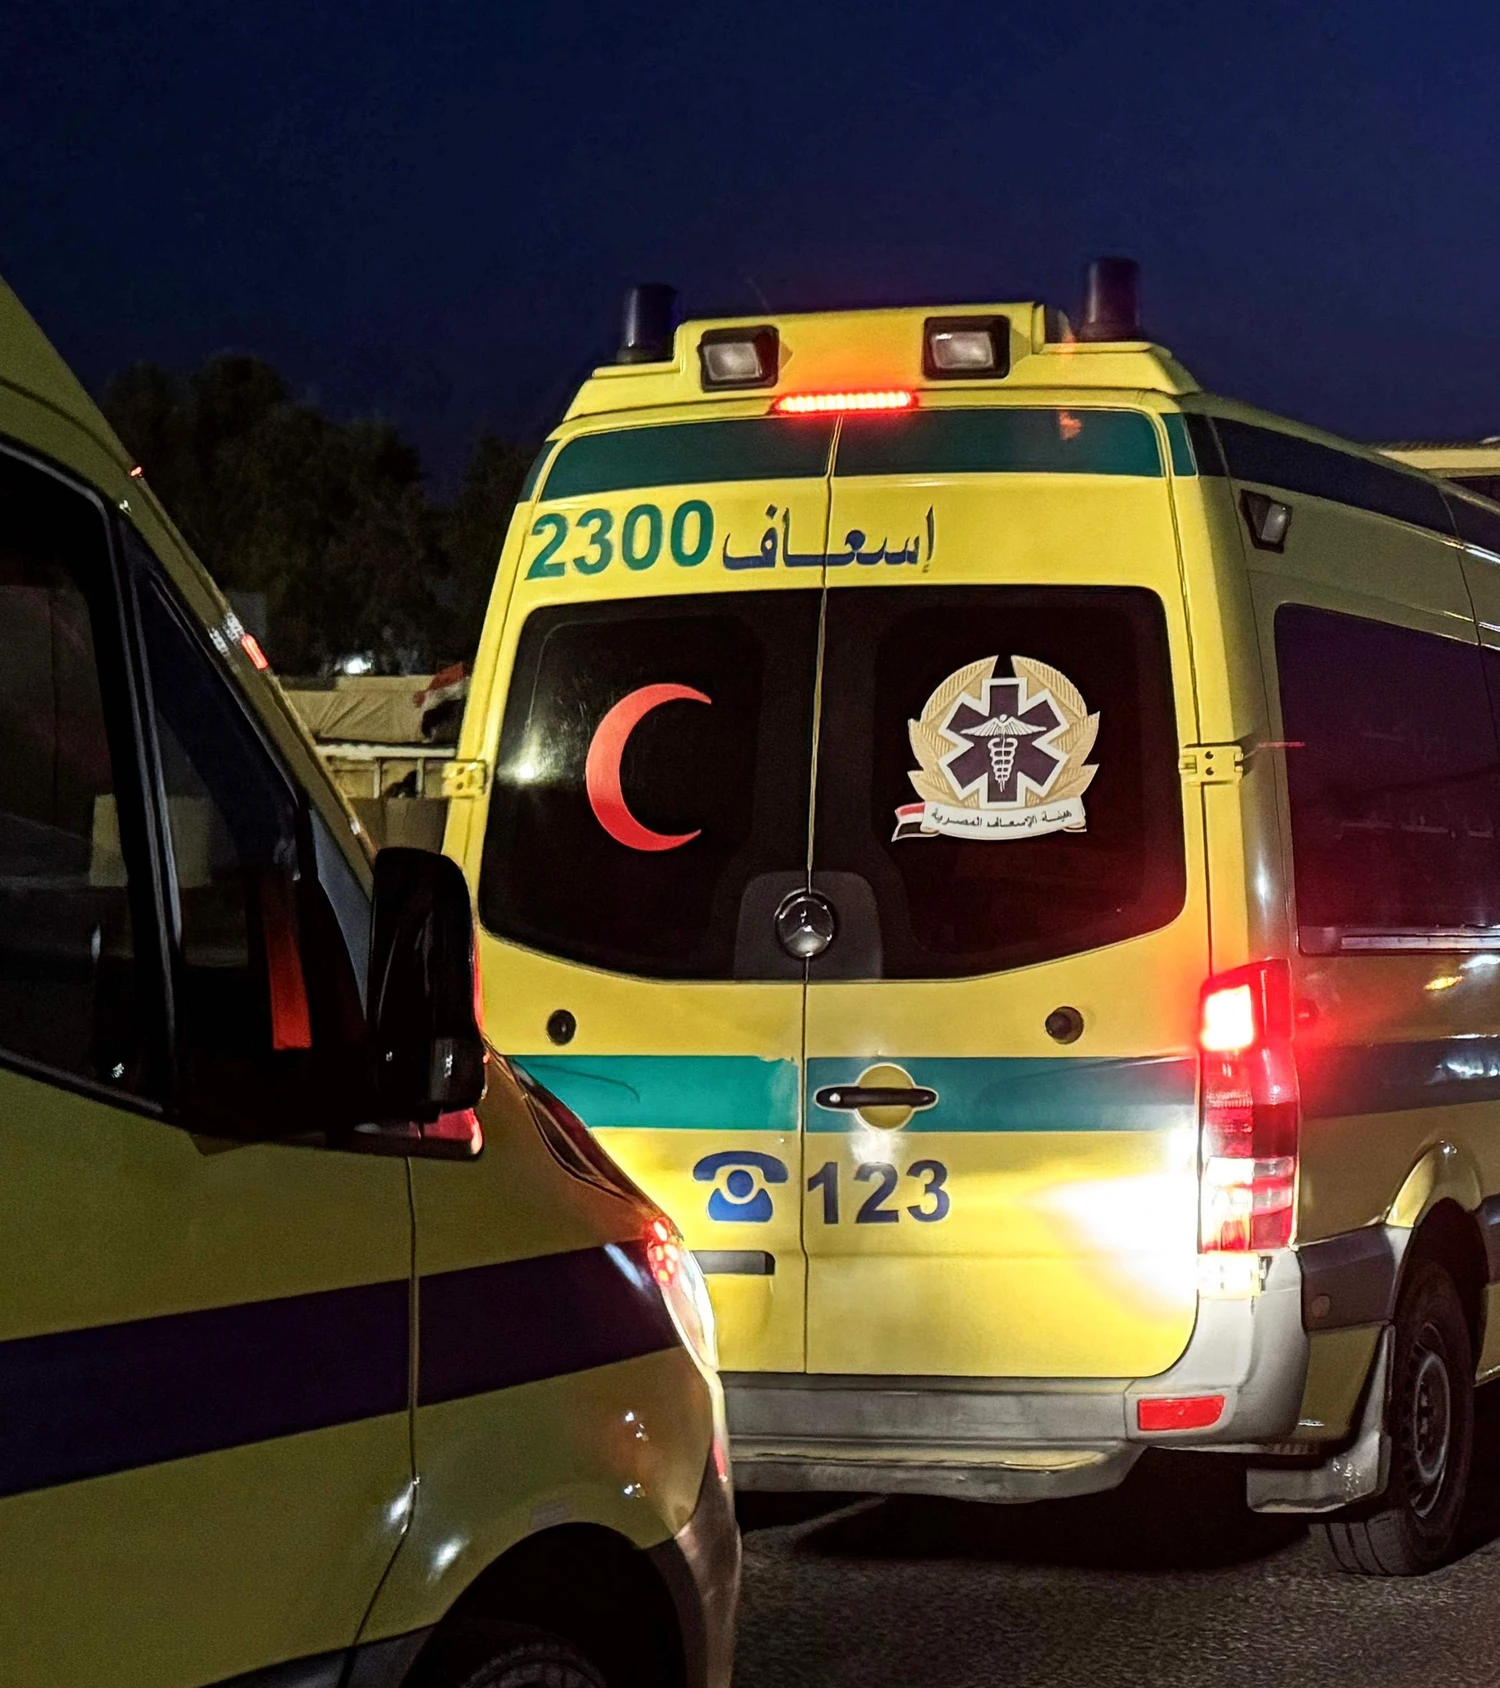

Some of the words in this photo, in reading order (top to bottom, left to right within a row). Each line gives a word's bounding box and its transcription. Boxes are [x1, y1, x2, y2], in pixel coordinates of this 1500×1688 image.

[525, 499, 715, 581] 2300
[721, 503, 935, 574] إسعاف
[807, 1159, 951, 1225] 123
